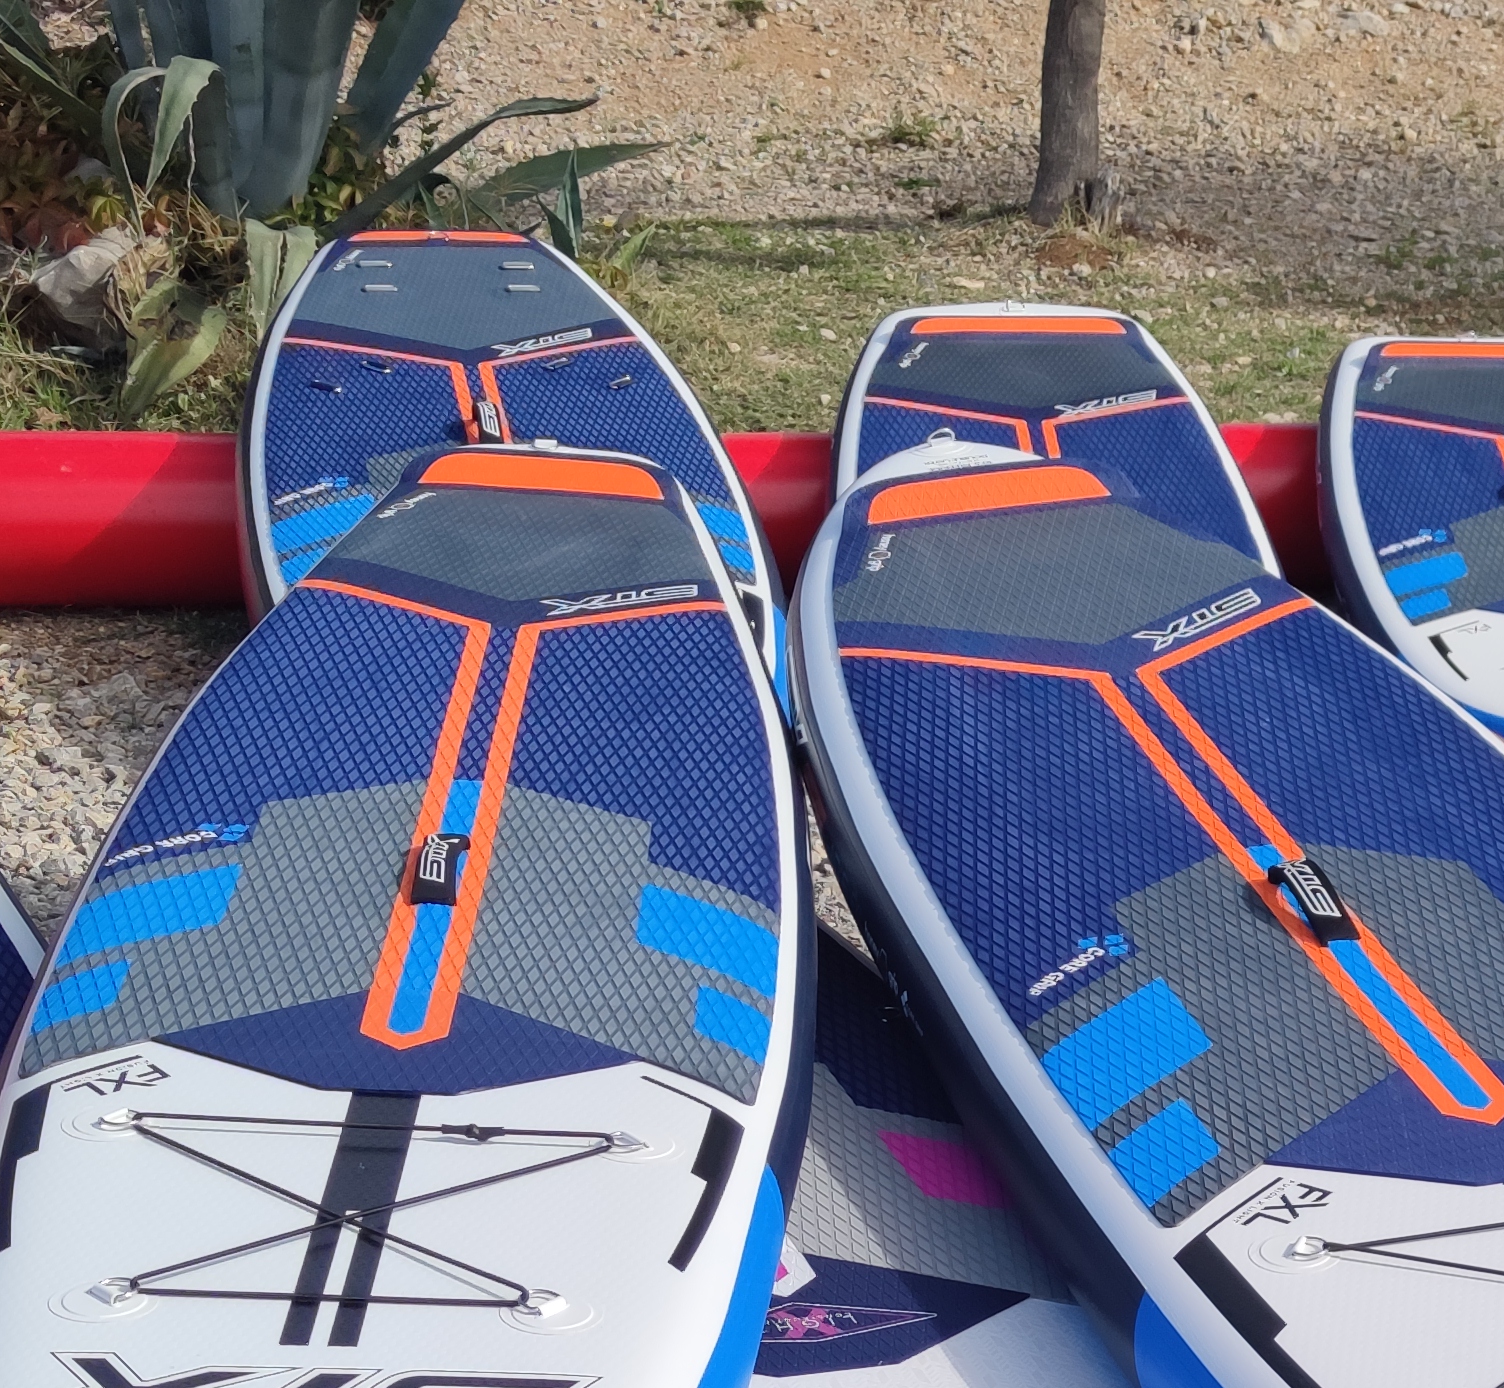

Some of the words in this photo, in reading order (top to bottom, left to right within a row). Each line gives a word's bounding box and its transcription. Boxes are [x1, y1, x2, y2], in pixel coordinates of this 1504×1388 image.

[491, 328, 592, 357] STX
[1054, 388, 1157, 415] STX
[539, 584, 698, 616] STX
[1131, 587, 1261, 652] STX
[419, 834, 461, 884] STX
[1279, 859, 1343, 917] STX
[1059, 947, 1106, 973] CORE
[62, 1063, 172, 1097] FXL
[1240, 1182, 1333, 1226] FXL
